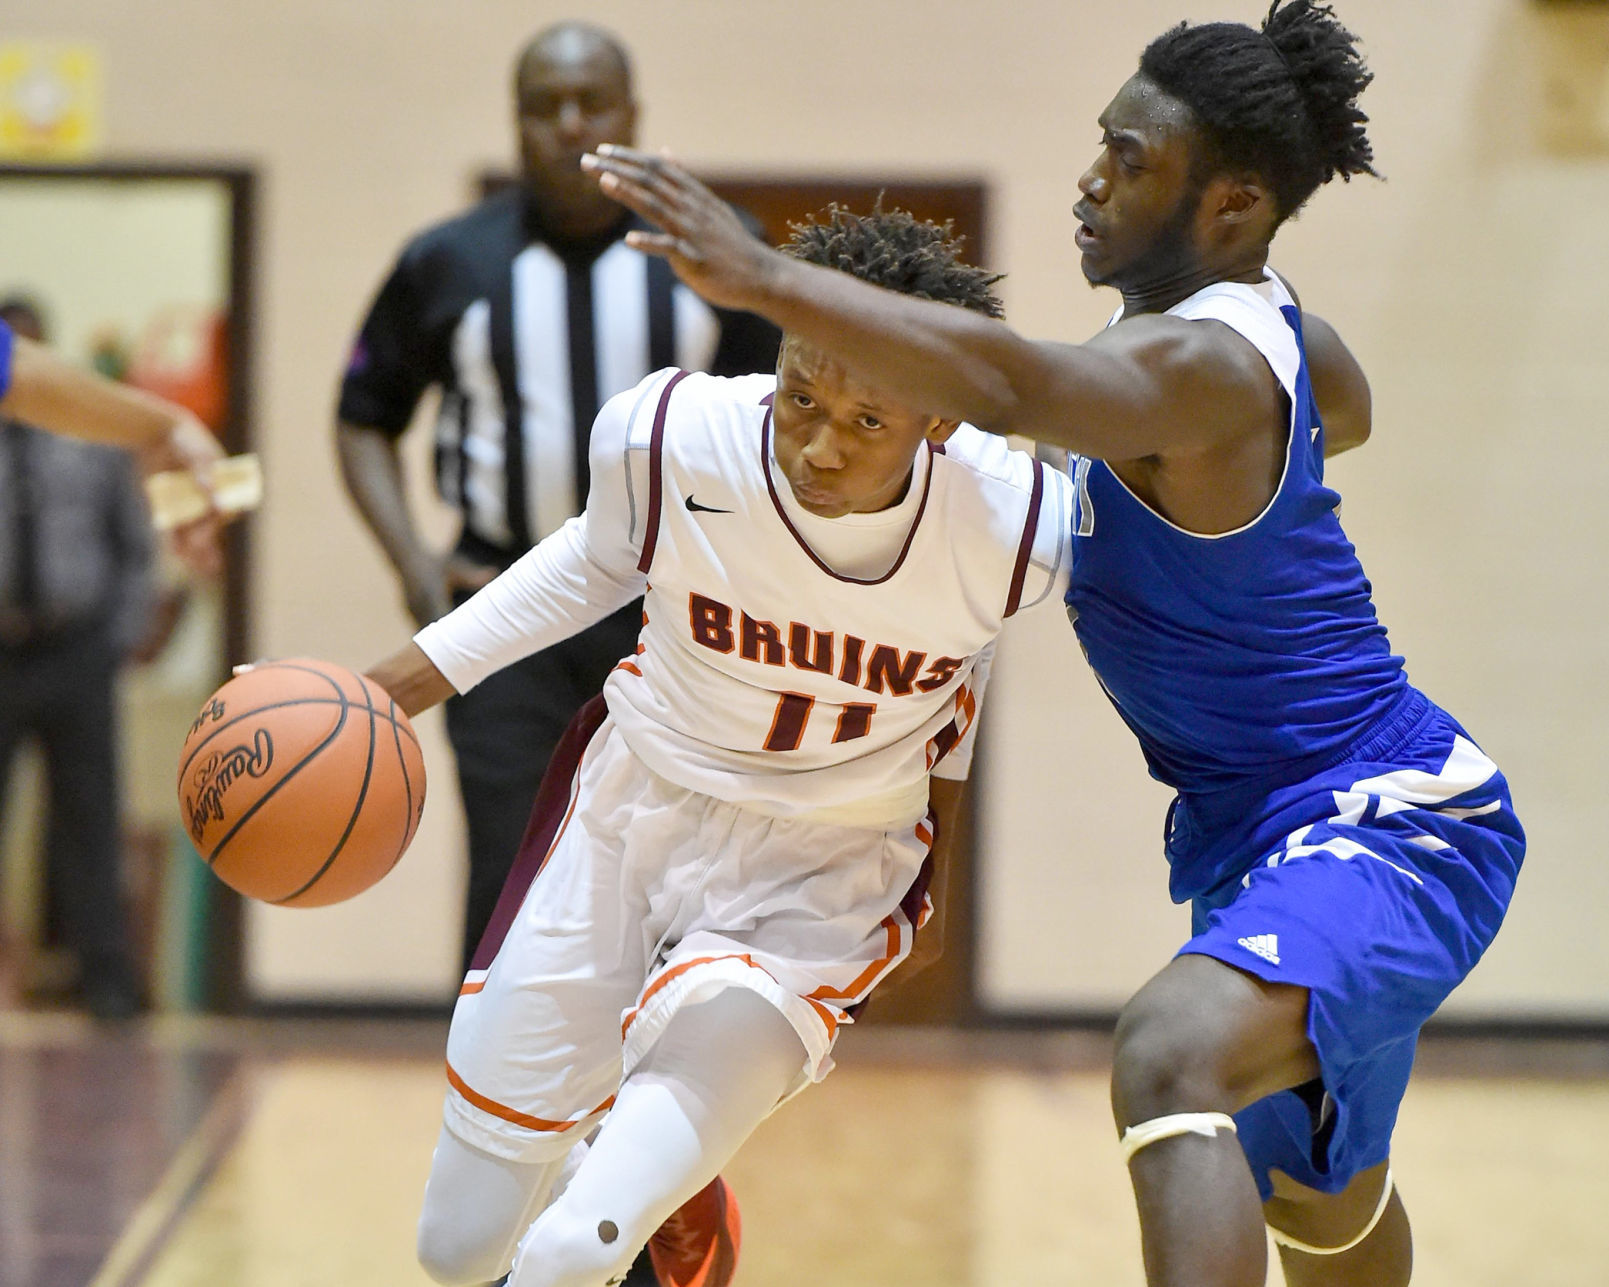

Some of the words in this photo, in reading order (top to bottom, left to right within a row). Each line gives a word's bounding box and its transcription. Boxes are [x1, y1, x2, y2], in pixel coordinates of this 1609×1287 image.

[688, 591, 964, 697] BRUINS
[762, 690, 877, 751] 11
[186, 728, 274, 845] Rawling
